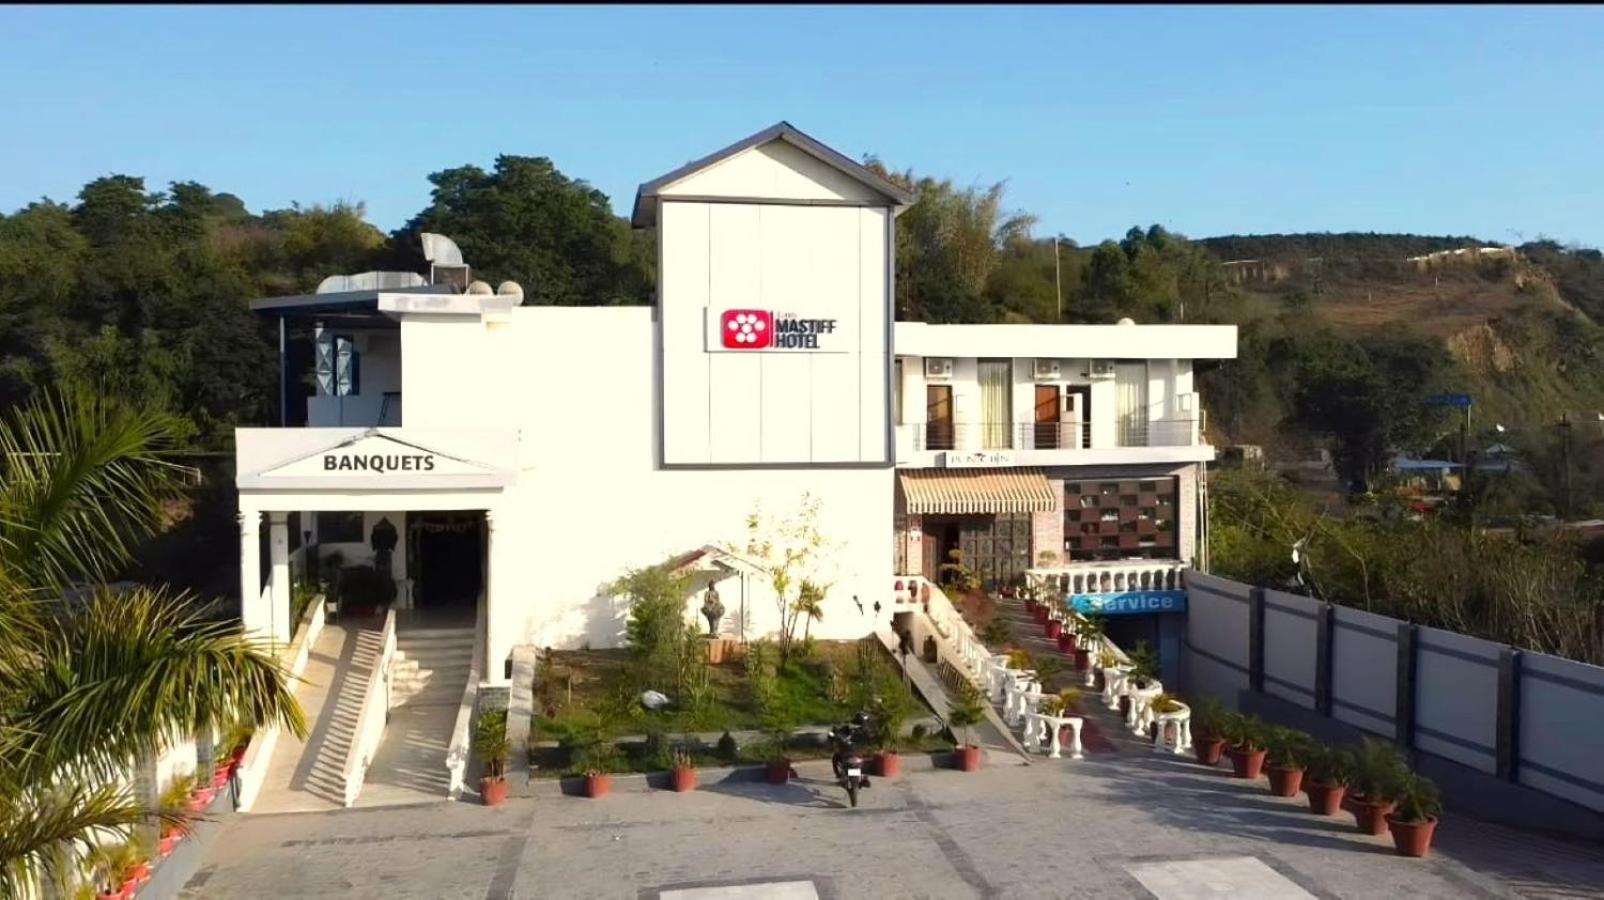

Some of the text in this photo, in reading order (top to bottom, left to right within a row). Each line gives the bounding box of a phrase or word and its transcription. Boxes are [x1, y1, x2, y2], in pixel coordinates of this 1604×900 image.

[775, 319, 837, 333] MASTIFF
[775, 333, 820, 348] HOTEL
[323, 454, 435, 473] BANQUETS
